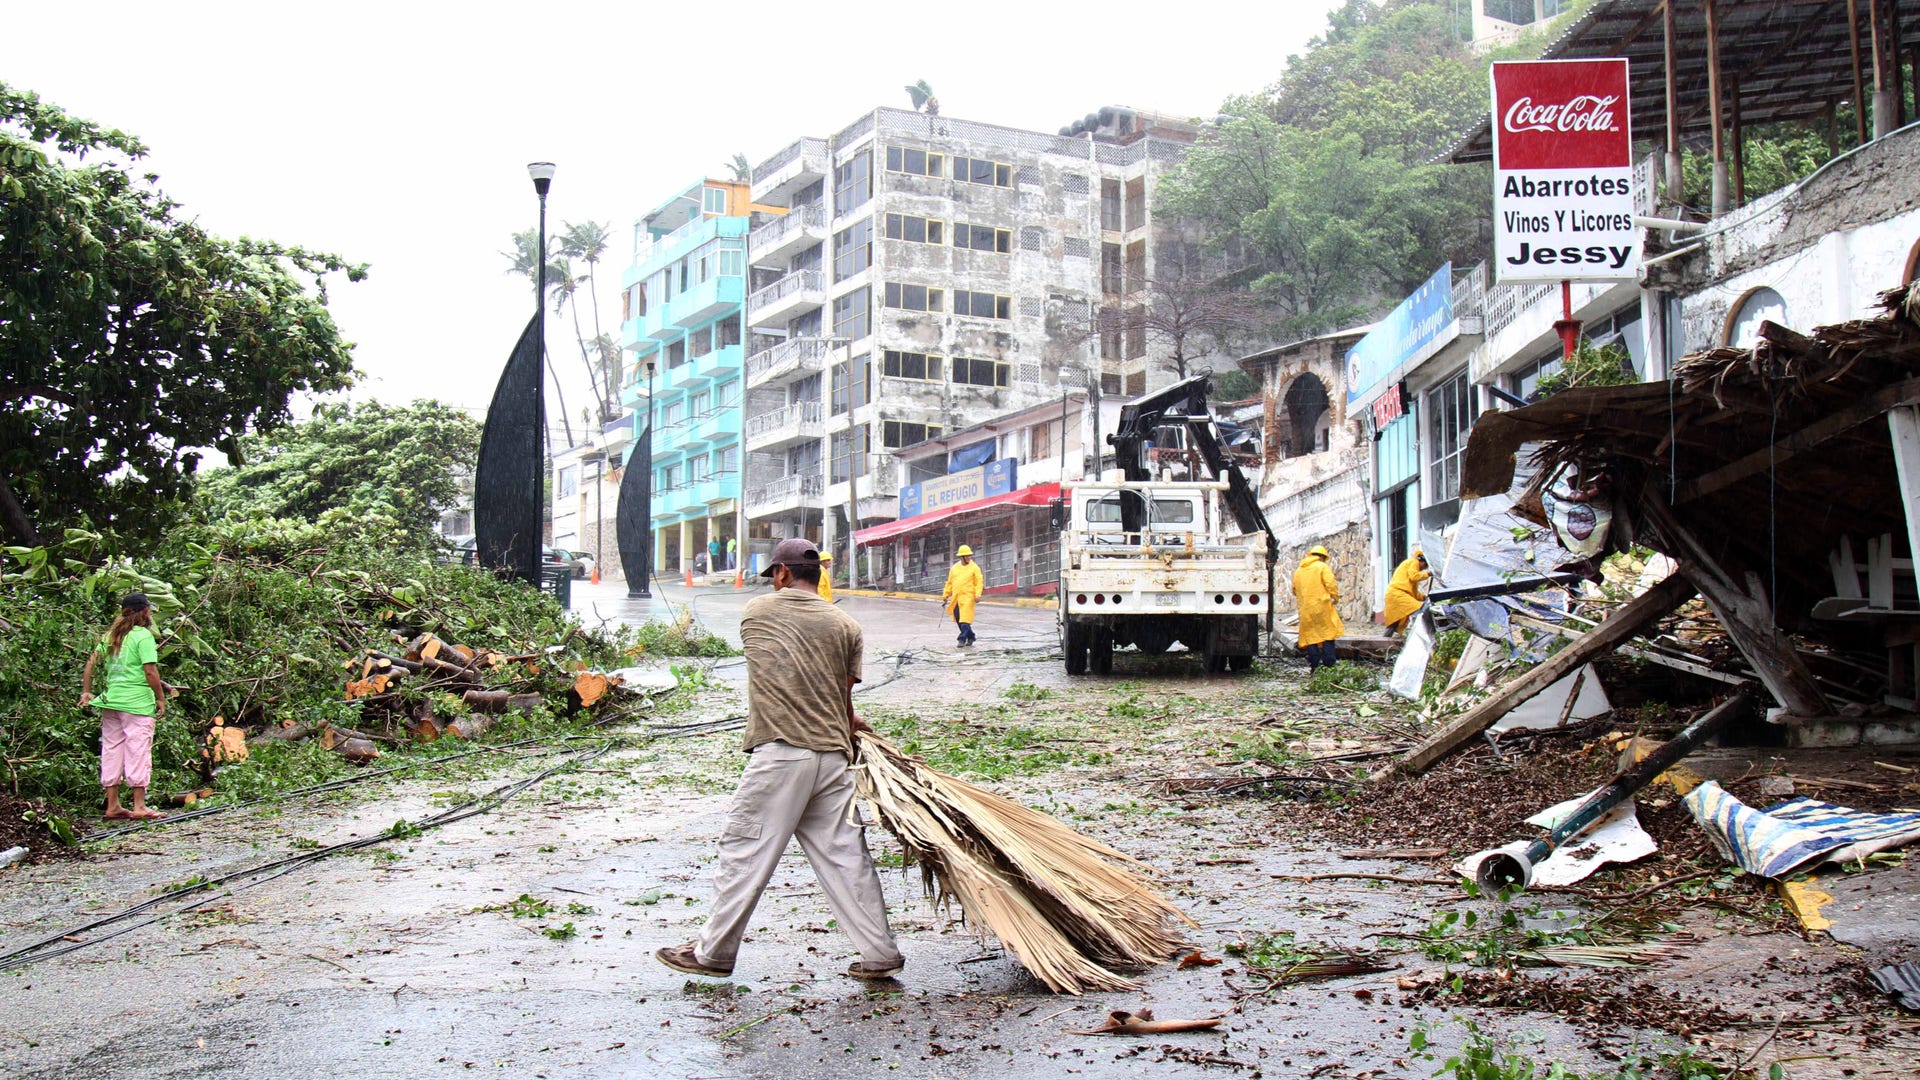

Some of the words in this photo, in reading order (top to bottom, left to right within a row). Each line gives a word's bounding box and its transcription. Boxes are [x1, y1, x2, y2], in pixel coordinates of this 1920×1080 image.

[1504, 95, 1620, 133] Coca-Cola
[1503, 174, 1630, 198] Abarrotes
[1504, 210, 1550, 233] Vinos
[1554, 209, 1566, 232] Y
[1571, 209, 1632, 232] Licores
[1506, 242, 1633, 269] Jessy
[927, 493, 938, 508] EL
[940, 483, 978, 505] REFUGIO
